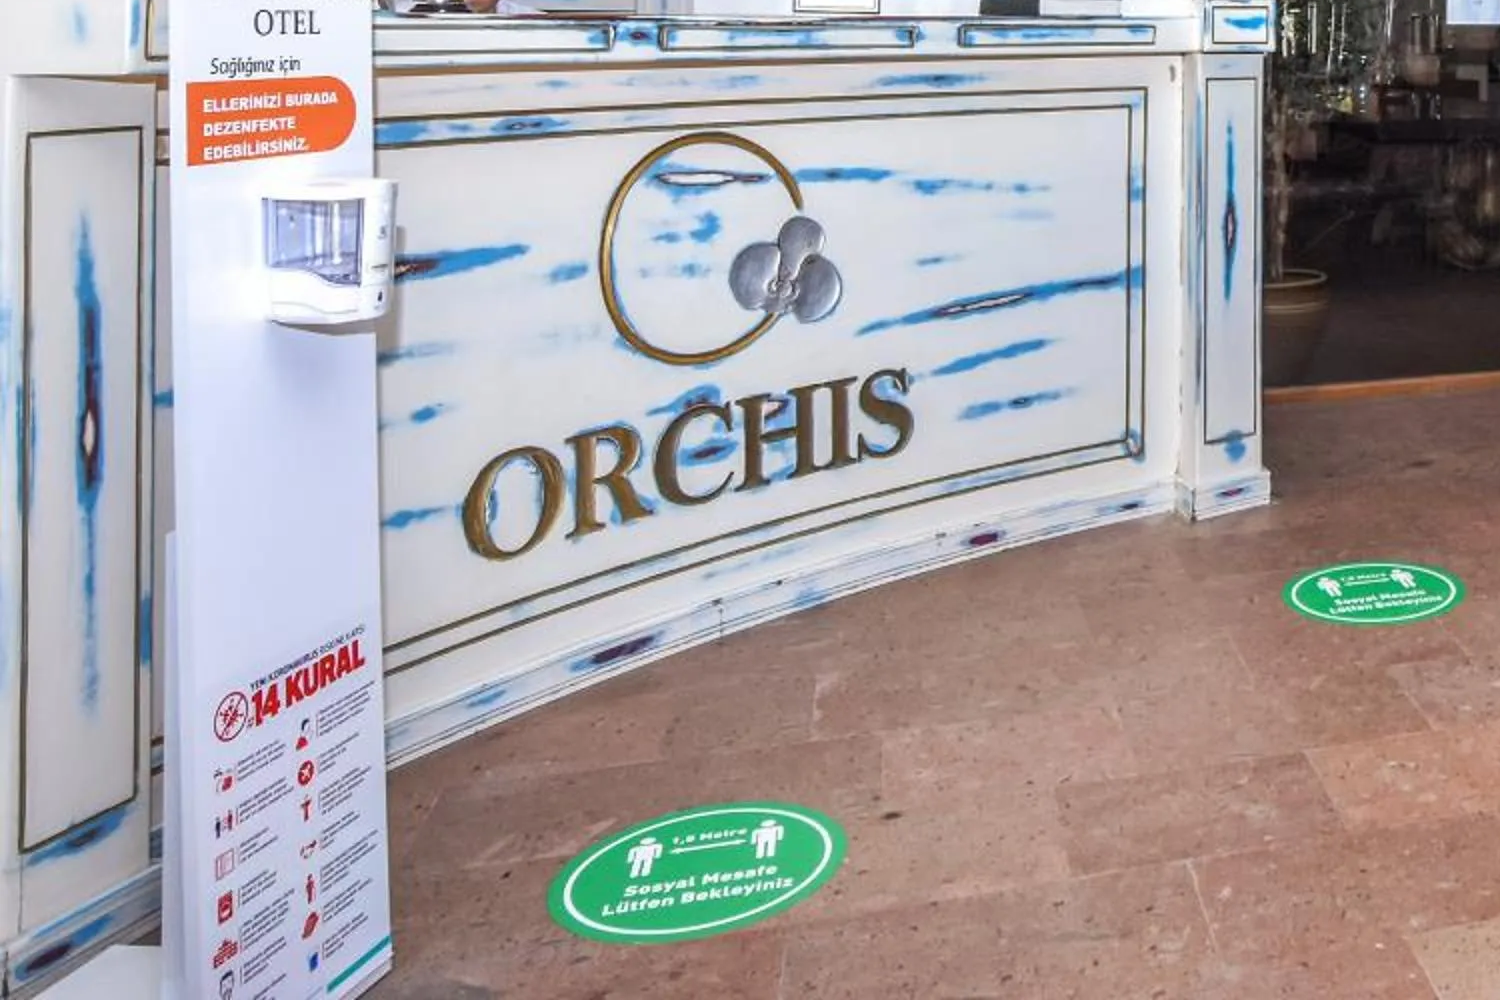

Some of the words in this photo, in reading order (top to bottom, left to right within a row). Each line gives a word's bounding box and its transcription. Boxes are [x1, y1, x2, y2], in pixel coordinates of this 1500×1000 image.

[253, 9, 321, 36] OTEL
[279, 55, 301, 77] için
[203, 91, 281, 113] ELLERİNİZİ
[285, 91, 339, 107] BURADA
[203, 116, 297, 137] DEZENFEKTE
[462, 367, 915, 561] ORCHIS
[252, 683, 280, 726] 14
[286, 640, 365, 708] KURAL
[601, 896, 674, 917] Lütfen
[680, 876, 794, 904] Bekleyiniz
[624, 876, 695, 898] Sosyal
[702, 865, 778, 885] Mesafe
